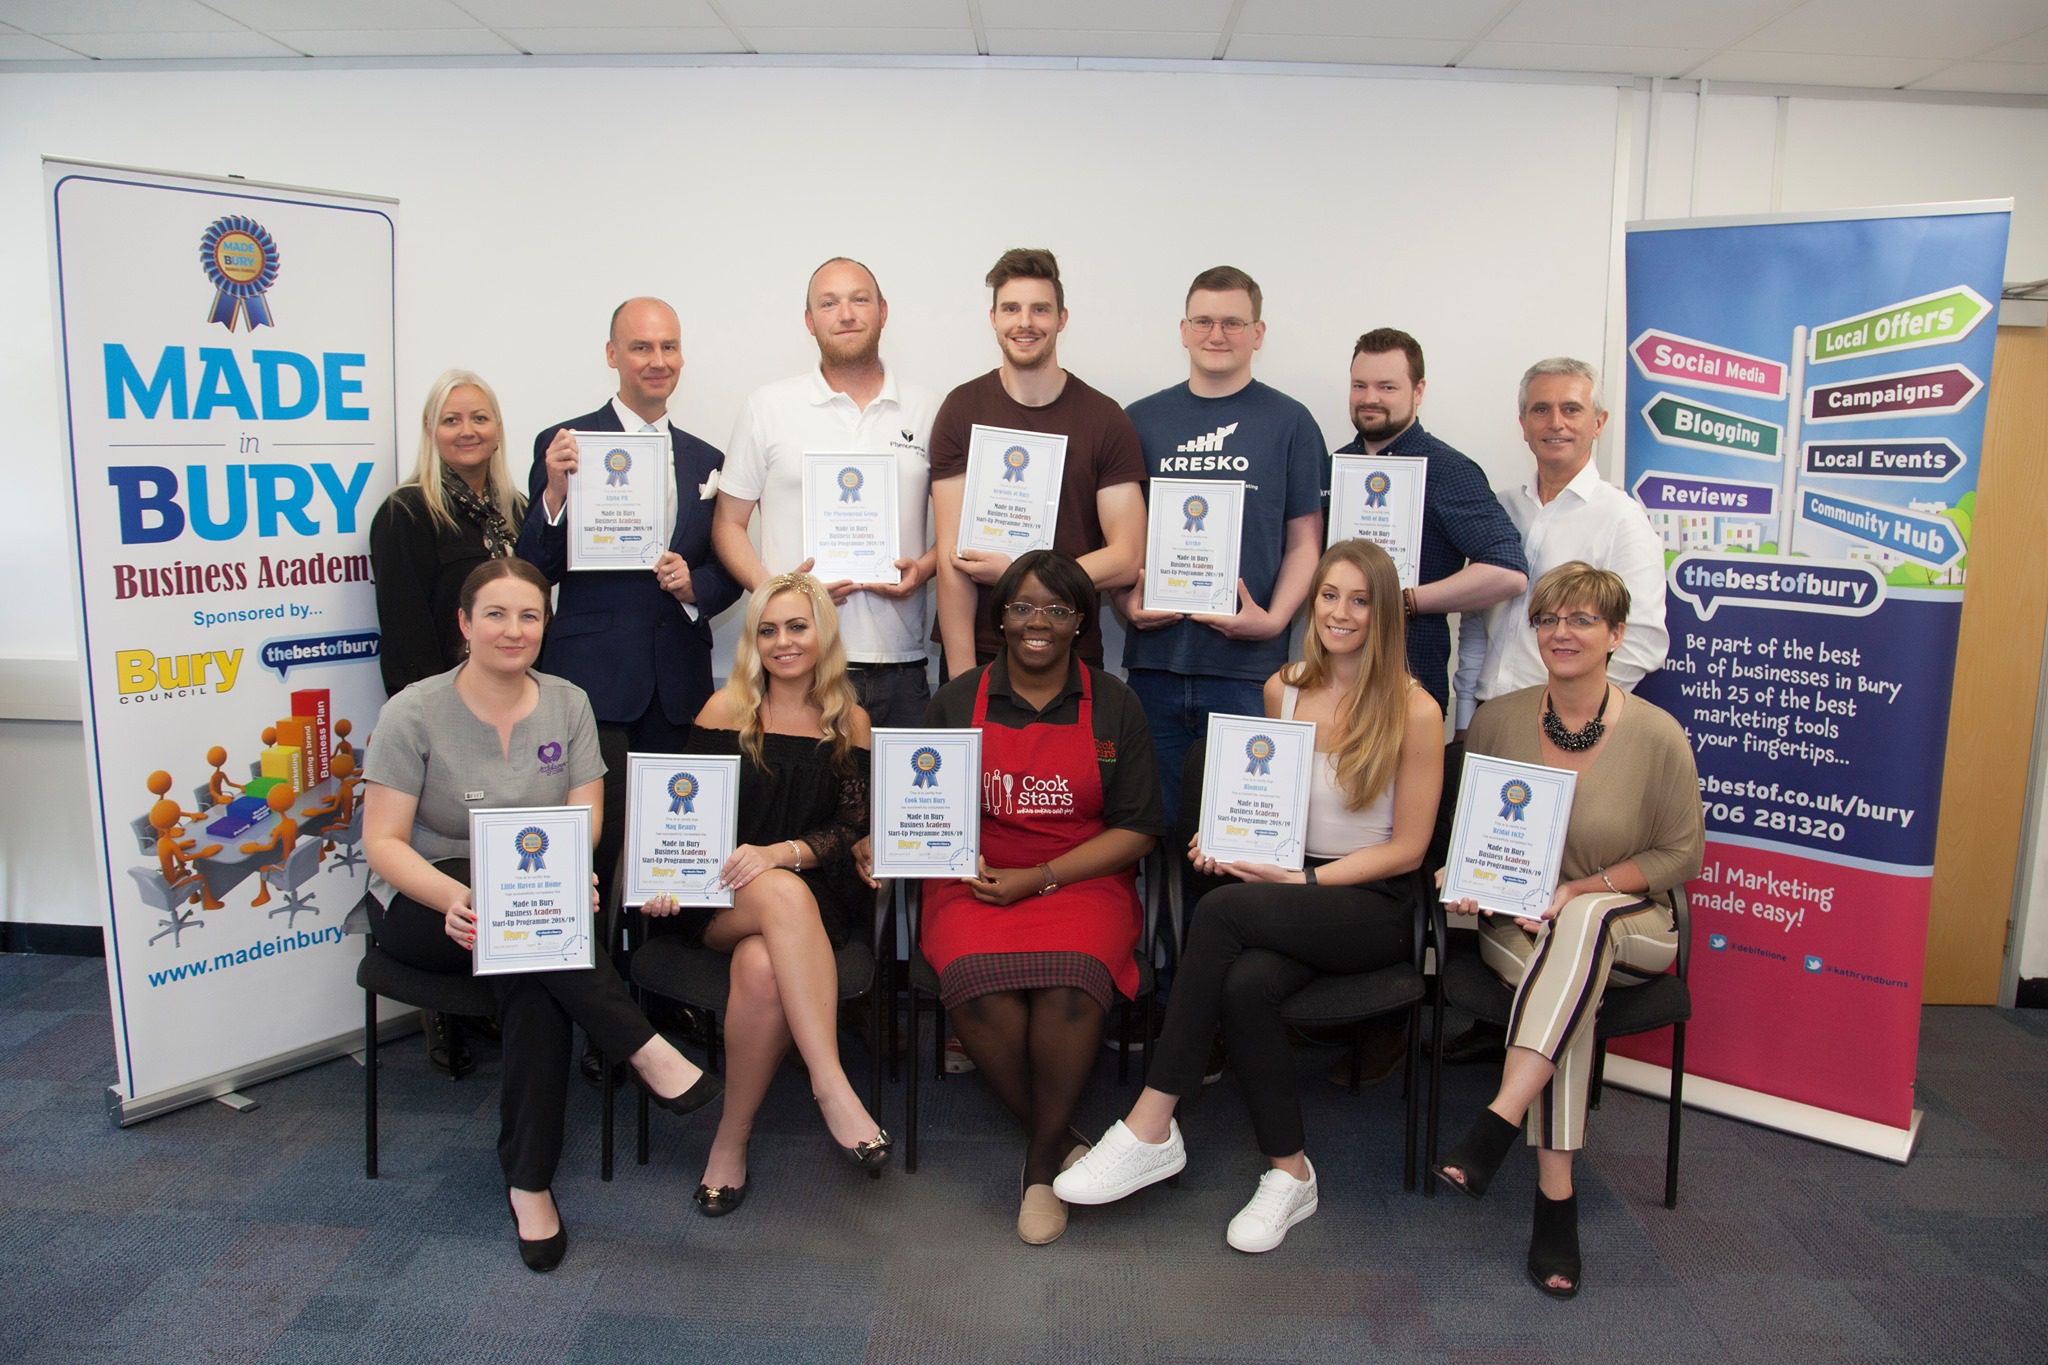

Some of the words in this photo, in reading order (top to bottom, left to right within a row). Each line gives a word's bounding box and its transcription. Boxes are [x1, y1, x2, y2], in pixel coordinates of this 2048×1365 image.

[223, 241, 255, 253] MADE
[224, 255, 255, 267] BURY
[1825, 323, 1868, 353] Local
[1875, 305, 1954, 342] Offers
[1653, 344, 1721, 377] Social
[1726, 361, 1766, 384] Media
[103, 343, 370, 421] MADE
[1828, 380, 1944, 409] Campaigns
[1674, 408, 1760, 448] Blogging
[239, 432, 260, 454] in
[1160, 456, 1249, 472] KRESKO
[1814, 450, 1863, 468] Local
[1870, 450, 1946, 469] Events
[107, 462, 375, 545] BURY
[1661, 484, 1748, 507] Reviews
[1810, 498, 1889, 537] Community
[1894, 522, 1945, 554] Hub
[113, 559, 248, 600] Business
[257, 551, 376, 591] Academ
[1684, 565, 1868, 603] thebestofbury
[193, 605, 285, 628] Sponsored
[290, 602, 323, 620] by...
[266, 637, 380, 663] thebestofbury
[1686, 634, 1706, 650] Be
[1711, 636, 1752, 657] part
[1757, 638, 1778, 658] of
[1783, 638, 1814, 660] the
[1819, 641, 1860, 667] best
[115, 647, 244, 695] Bury
[1663, 653, 1696, 674] nch
[1707, 658, 1727, 678] of
[1732, 657, 1829, 688] businesses
[1835, 672, 1852, 690] in
[1858, 675, 1902, 704] Bury
[120, 687, 207, 705] COUNCIL
[1681, 680, 1721, 700] with
[1727, 685, 1749, 704] 25
[1755, 687, 1775, 706] of
[1779, 687, 1810, 710] the
[1815, 691, 1857, 717] best
[316, 700, 325, 726] Plan
[1694, 705, 1791, 737] marketing
[1795, 716, 1839, 739] tools
[303, 725, 313, 749] brand
[1697, 732, 1738, 752] your
[1743, 732, 1850, 767] fingertips...
[319, 727, 330, 780] Business
[1022, 775, 1069, 792] Cook
[1018, 792, 1073, 806] stars
[1238, 799, 1252, 807] Made
[1260, 801, 1273, 809] Bury
[1698, 775, 1915, 828] ebestof.co.uk/bury
[926, 821, 952, 829] Academy
[931, 813, 944, 821] Bury
[1230, 807, 1253, 815] Business
[1255, 809, 1280, 818] Academy
[1238, 816, 1267, 824] Programme
[1702, 802, 1745, 823] 706
[1754, 809, 1846, 841] 281320
[681, 848, 707, 856] Academy
[687, 840, 700, 848] Bury
[1487, 842, 1502, 851] Made
[1511, 848, 1525, 856] Bury
[1478, 850, 1503, 860] Business
[1504, 855, 1530, 866] Academy
[1486, 860, 1518, 872] Programme
[1726, 866, 1835, 912] Marketing
[505, 909, 532, 917] Business
[534, 908, 562, 916] Academy
[539, 899, 554, 907] Bury
[1691, 891, 1746, 914] made
[1752, 901, 1805, 933] easy!
[516, 918, 550, 926] Programme
